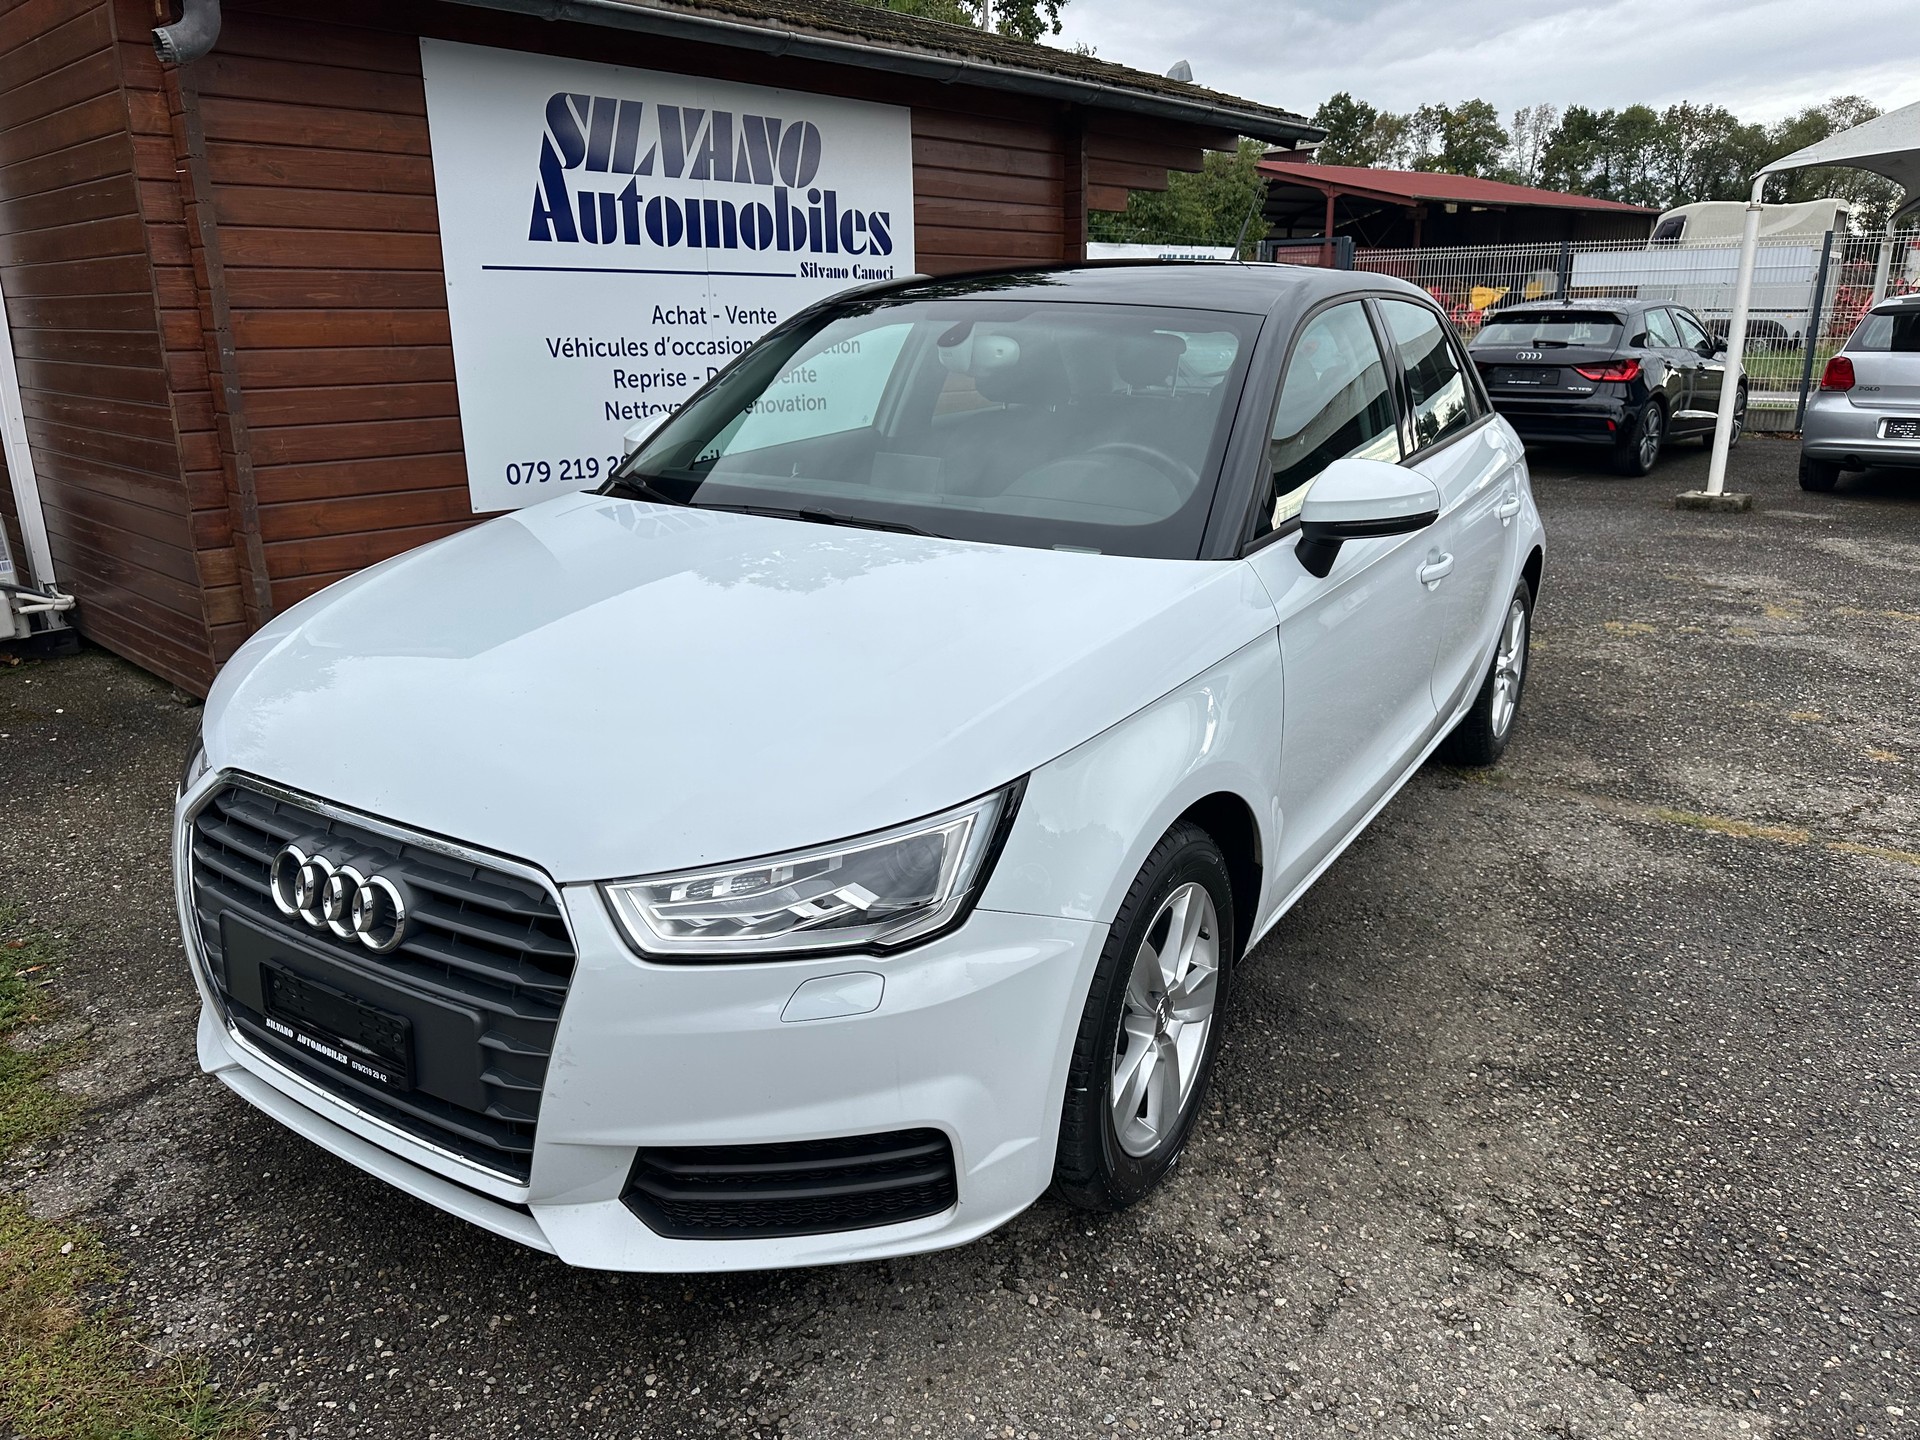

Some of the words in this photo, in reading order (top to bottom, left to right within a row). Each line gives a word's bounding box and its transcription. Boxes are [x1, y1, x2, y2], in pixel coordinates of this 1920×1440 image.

[545, 92, 822, 189] SILVANO
[528, 131, 893, 256] Automobiles
[800, 262, 849, 279] Silvano
[852, 264, 894, 280] Canoci
[652, 305, 707, 325] Achat
[725, 305, 777, 325] Vente
[546, 337, 648, 358] Véhicules
[613, 368, 687, 392] Reprise
[506, 460, 551, 485] 079
[559, 457, 600, 480] 219
[266, 1018, 294, 1038] SILVANO
[297, 1033, 348, 1065] AUTOMOBILES
